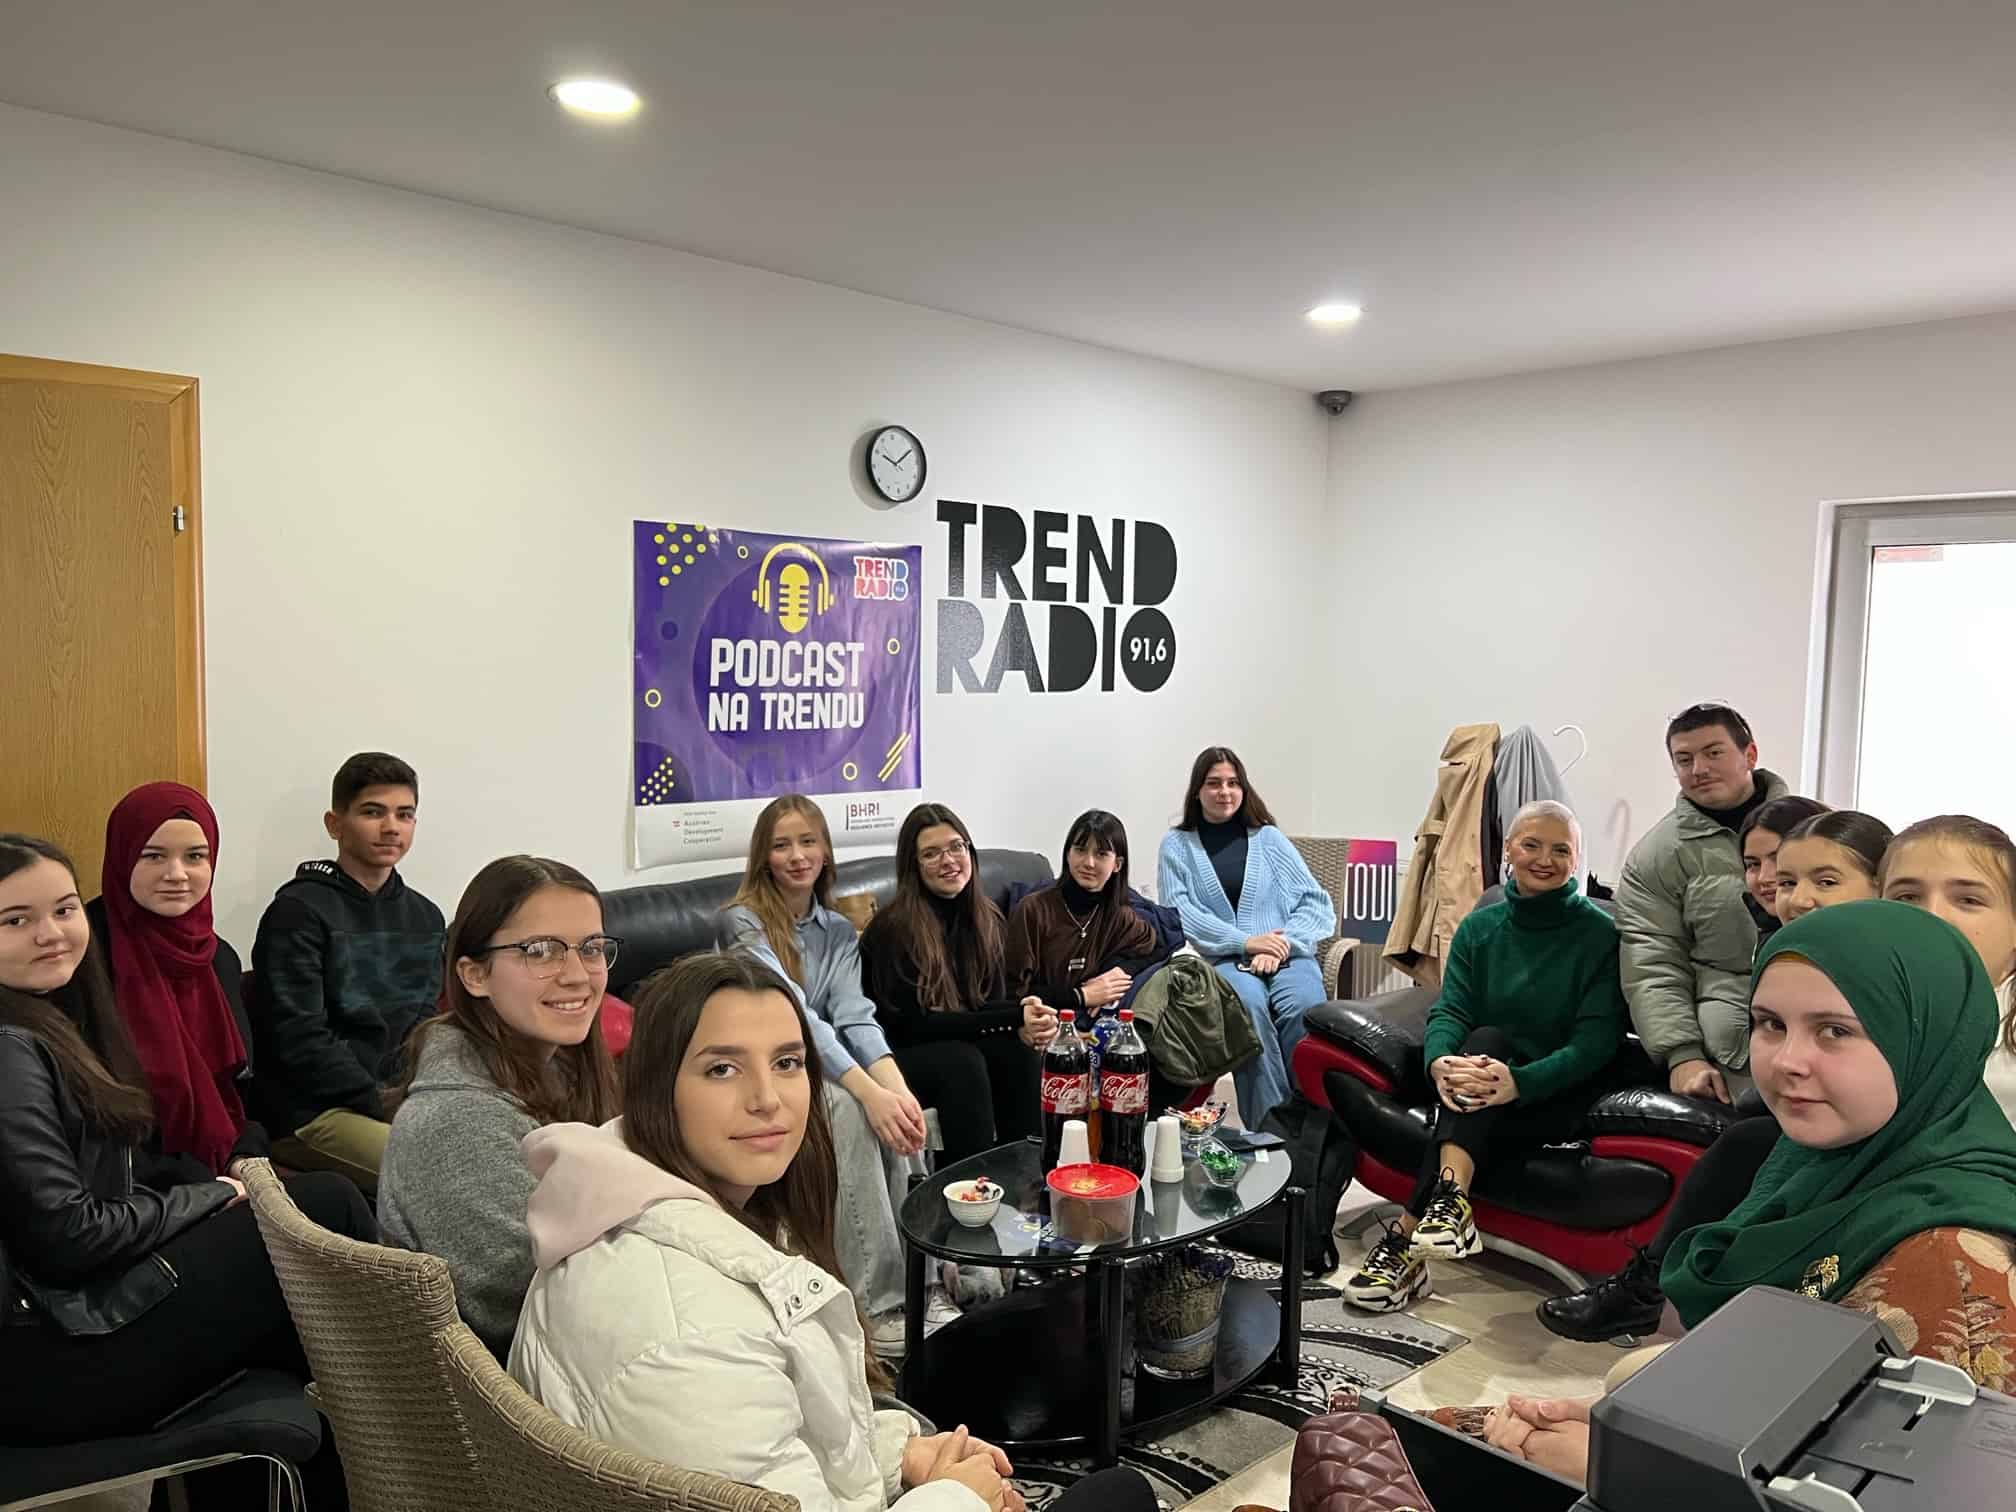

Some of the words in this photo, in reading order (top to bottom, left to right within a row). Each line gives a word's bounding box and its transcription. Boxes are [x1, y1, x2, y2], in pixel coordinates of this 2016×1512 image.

[855, 558, 907, 579] TREND
[937, 500, 1177, 605] TREND
[855, 578, 906, 599] RADIO
[710, 638, 865, 687] PODCAST
[936, 599, 1177, 693] RADIO
[1130, 637, 1167, 664] 91,6
[708, 692, 749, 731] NA
[760, 692, 865, 731] TRENDU
[850, 802, 880, 817] BHRI
